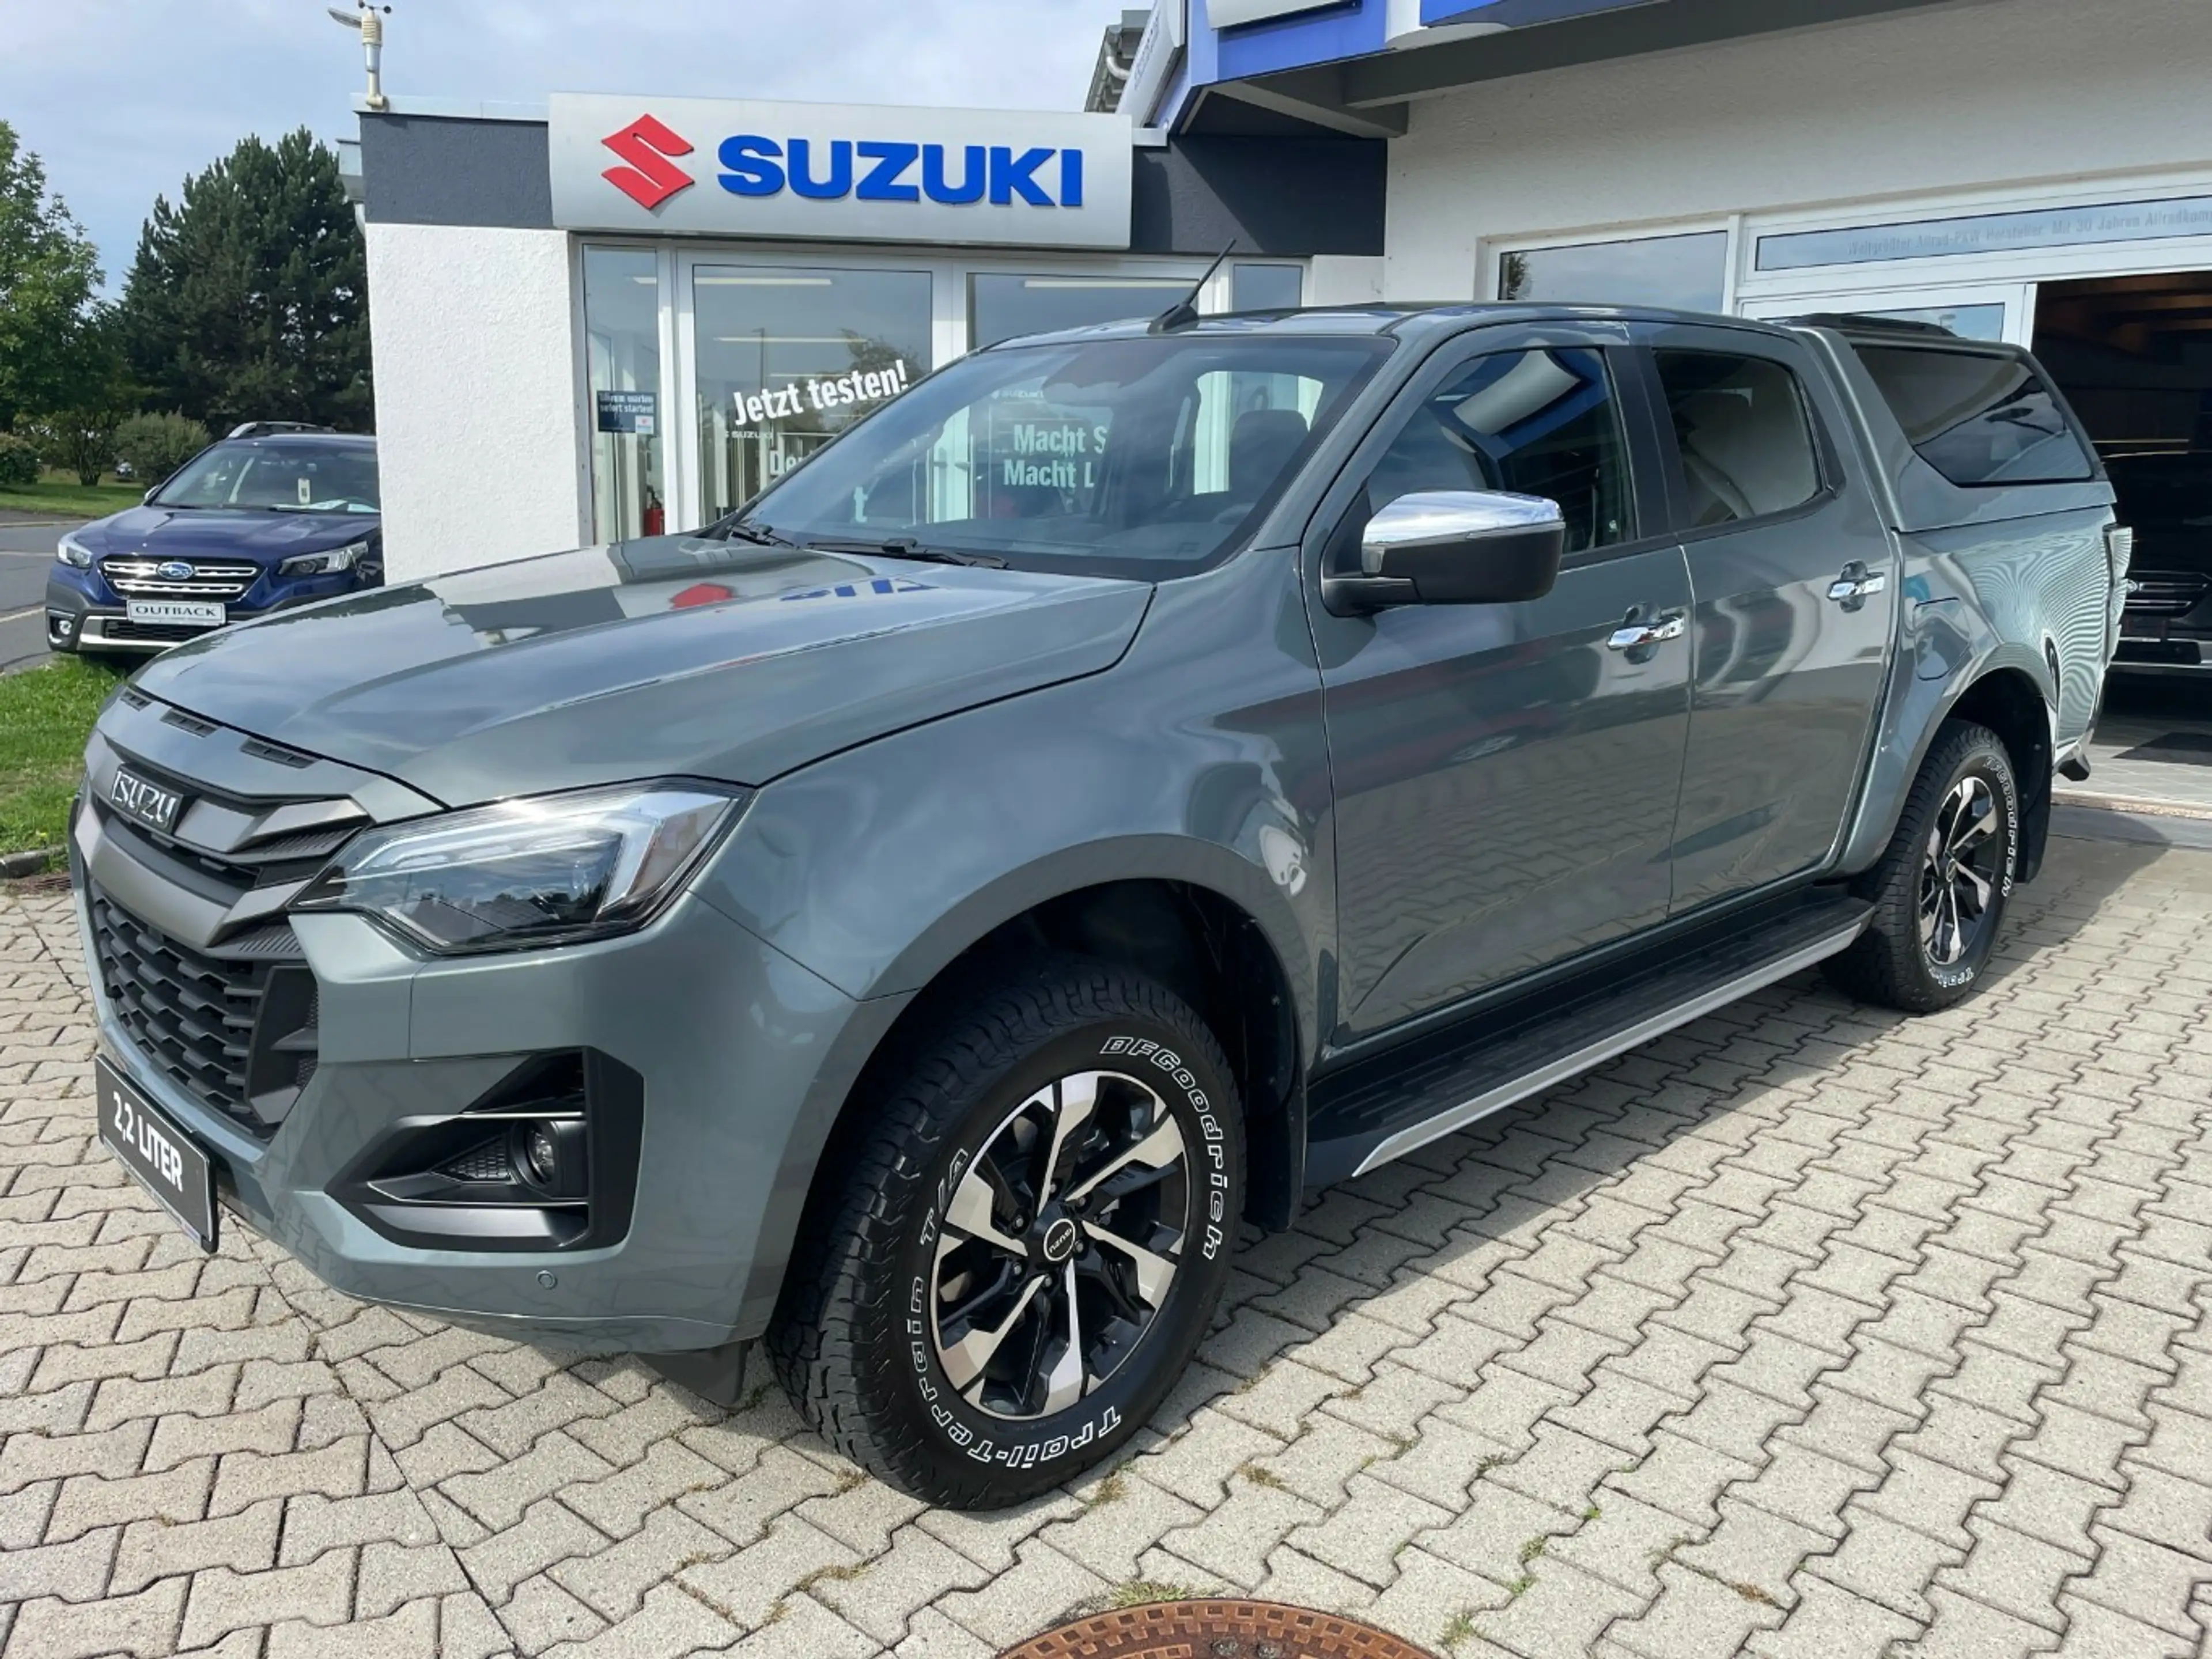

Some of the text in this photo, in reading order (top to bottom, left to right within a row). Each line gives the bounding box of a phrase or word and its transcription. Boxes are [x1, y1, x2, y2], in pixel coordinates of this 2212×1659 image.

[718, 134, 1083, 207] SUZUKI
[733, 359, 909, 425] Jetzt testen!
[1014, 425, 1087, 454] Macht
[1004, 459, 1076, 488] Macht
[135, 606, 216, 616] OUTBACK
[112, 771, 177, 828] ISUZU
[113, 1090, 183, 1192] 2,2 LITER
[1100, 1037, 1223, 1260] BFGoodrich
